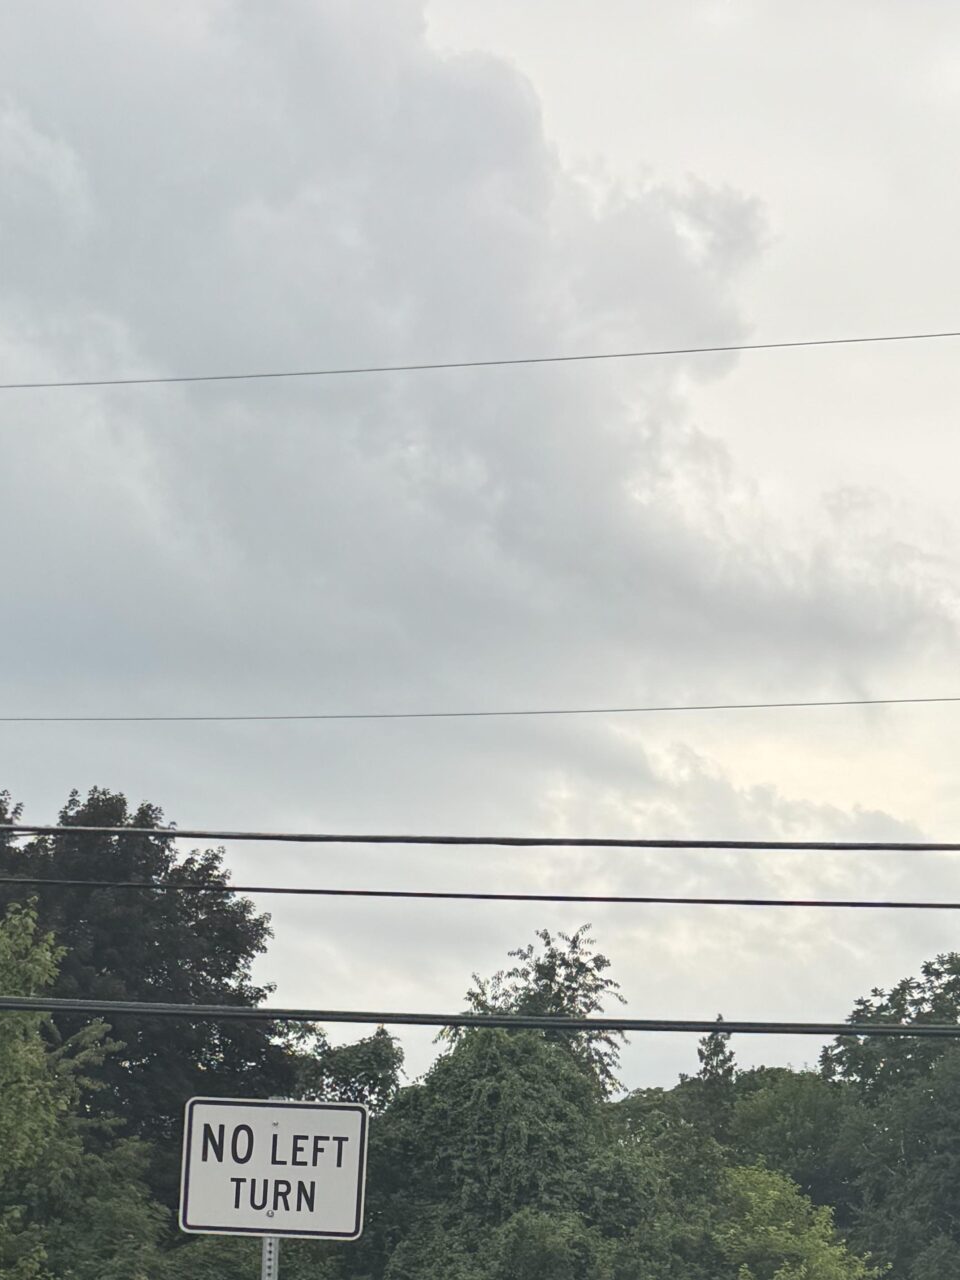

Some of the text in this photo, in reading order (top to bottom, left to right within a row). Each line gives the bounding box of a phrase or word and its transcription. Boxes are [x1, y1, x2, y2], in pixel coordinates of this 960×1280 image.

[201, 1123, 349, 1168] NO LEFT
[230, 1177, 316, 1212] TURN
